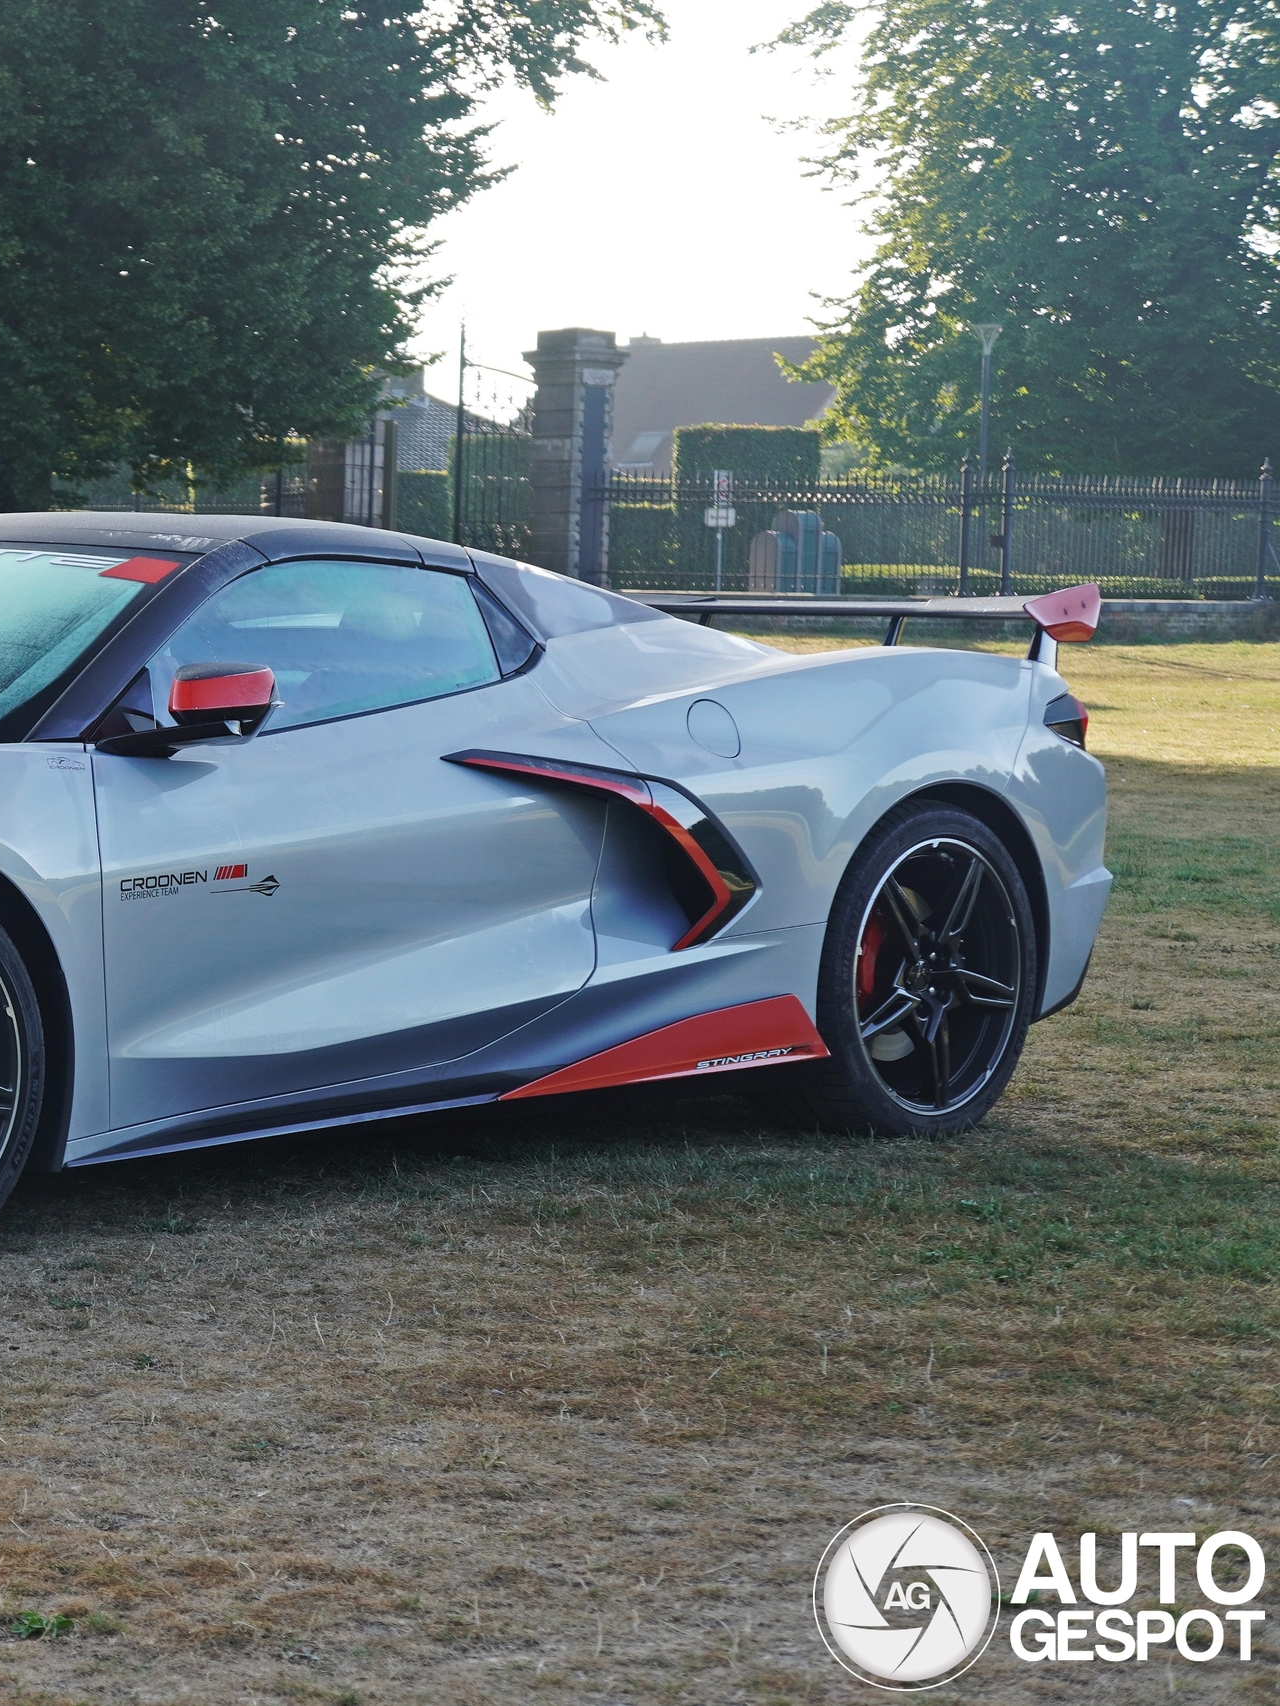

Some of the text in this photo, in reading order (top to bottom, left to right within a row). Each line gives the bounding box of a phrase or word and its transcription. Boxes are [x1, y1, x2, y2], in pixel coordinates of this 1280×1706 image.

[120, 870, 208, 891] CROONEN
[120, 886, 180, 901] EXPERIENCE TEAM
[696, 1047, 793, 1069] STINGRAY
[12, 1078, 40, 1167] MICHELIN
